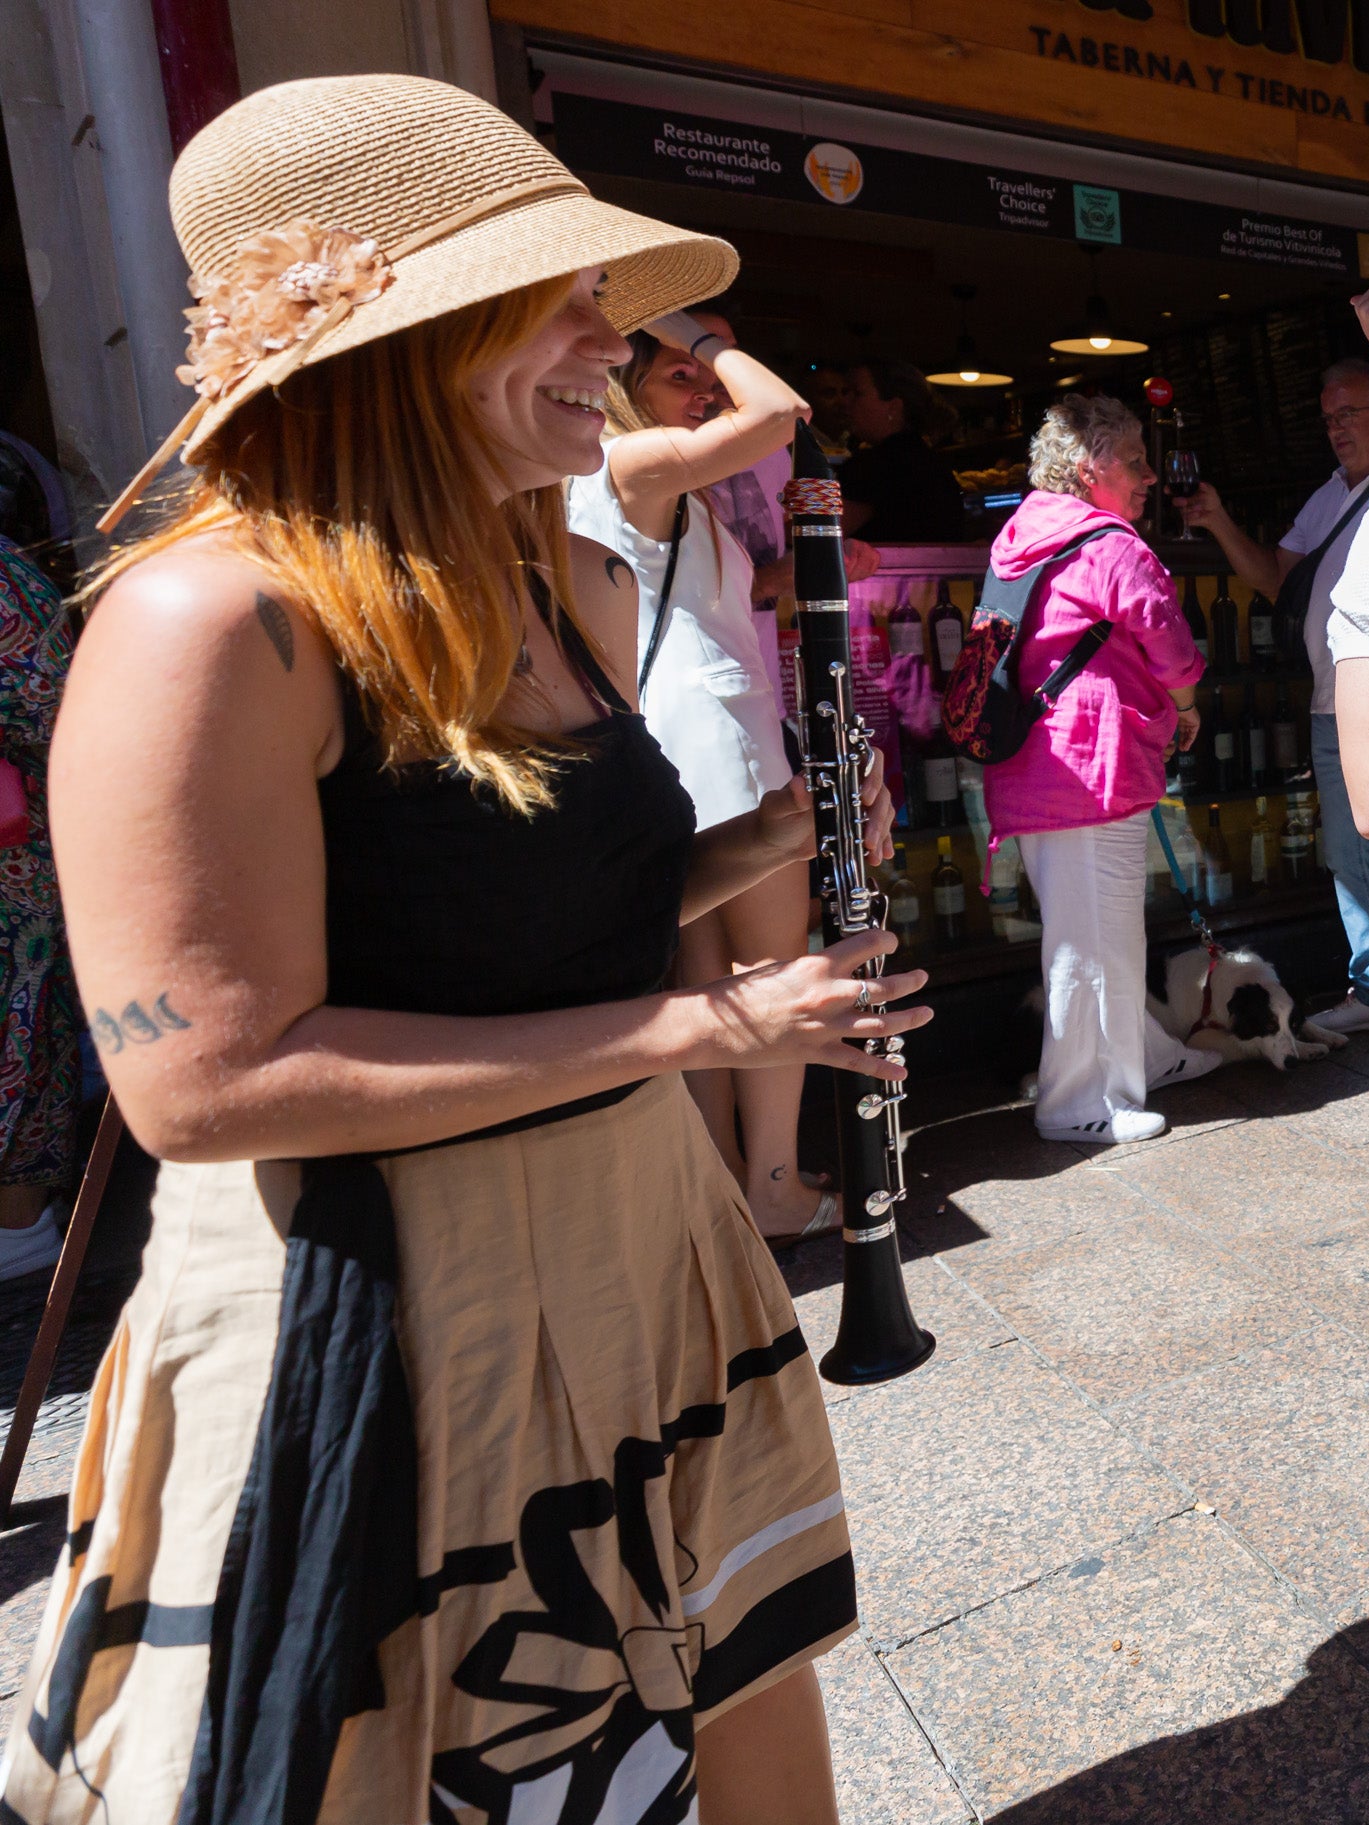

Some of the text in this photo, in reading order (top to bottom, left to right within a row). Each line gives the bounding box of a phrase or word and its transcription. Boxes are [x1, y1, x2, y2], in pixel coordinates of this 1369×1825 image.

[1029, 25, 1196, 89] TABERNA
[1204, 66, 1228, 93] Y
[1234, 71, 1352, 121] TIENDA
[662, 122, 771, 154] Restaurante
[654, 138, 782, 174] Recomendado
[715, 168, 756, 186] Repsol
[986, 176, 1057, 200] Travellers'
[999, 194, 1047, 214] Choice
[998, 211, 1051, 228] Tripadvisor
[1241, 217, 1323, 242] Premio Best Of
[1222, 229, 1238, 242] de
[1239, 232, 1283, 250] Turismo
